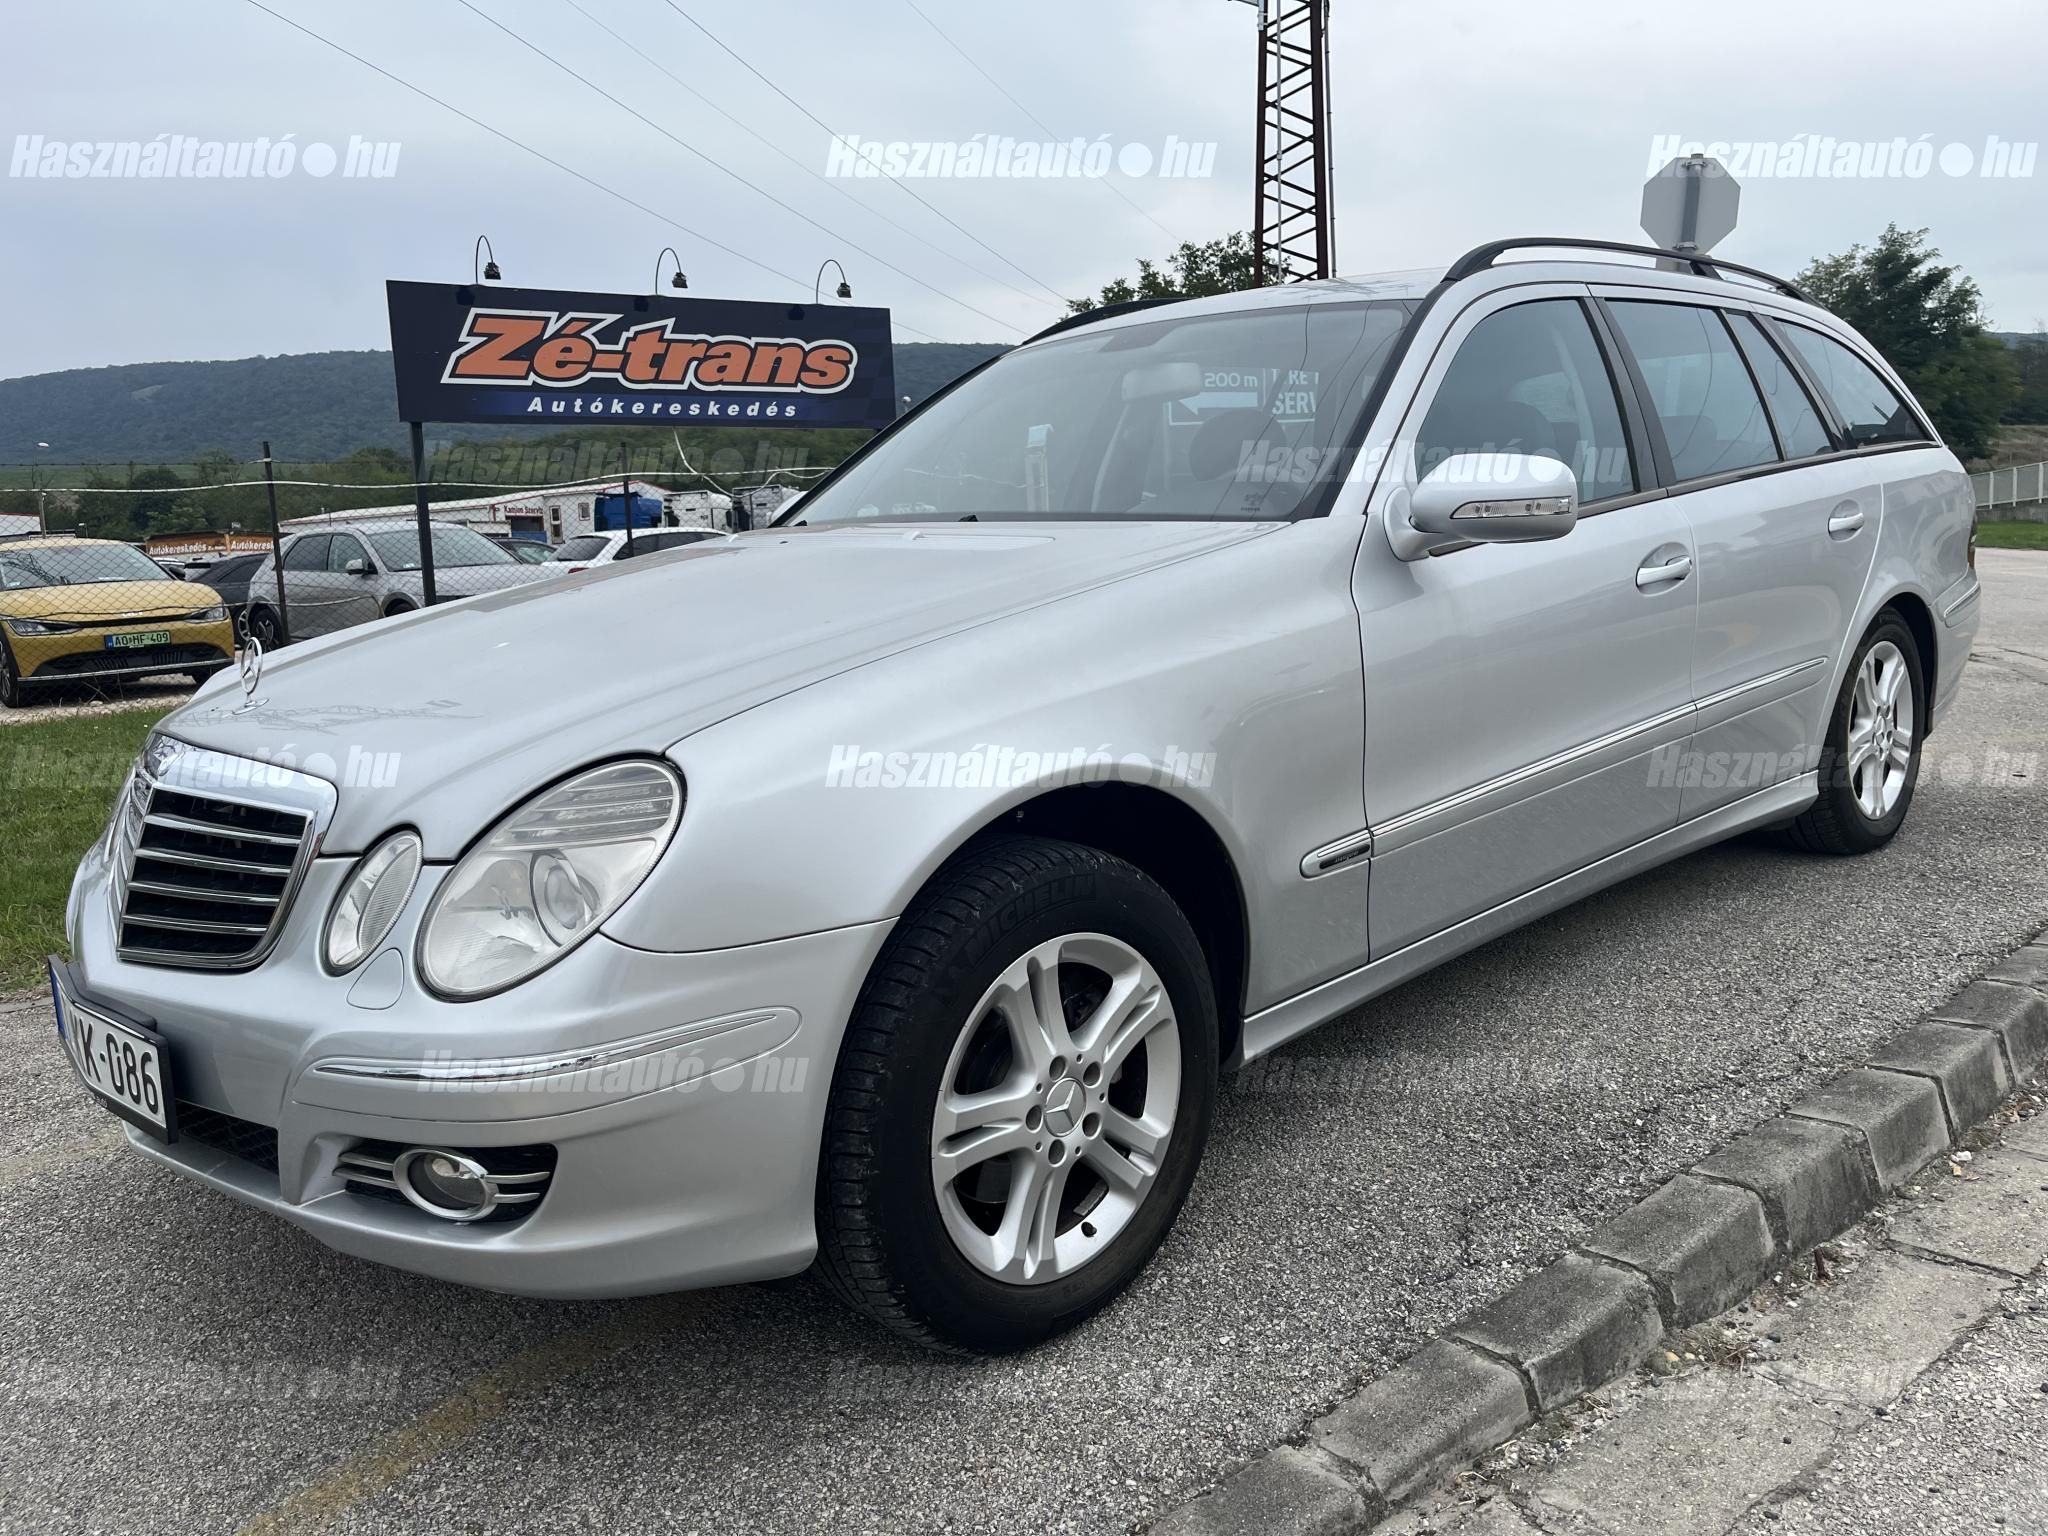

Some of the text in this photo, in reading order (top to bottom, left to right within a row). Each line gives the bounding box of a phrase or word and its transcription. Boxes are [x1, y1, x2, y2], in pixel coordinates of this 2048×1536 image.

[444, 308, 858, 394] Zé-trans
[1204, 372, 1240, 387] 200
[527, 396, 797, 419] Autókereskedés
